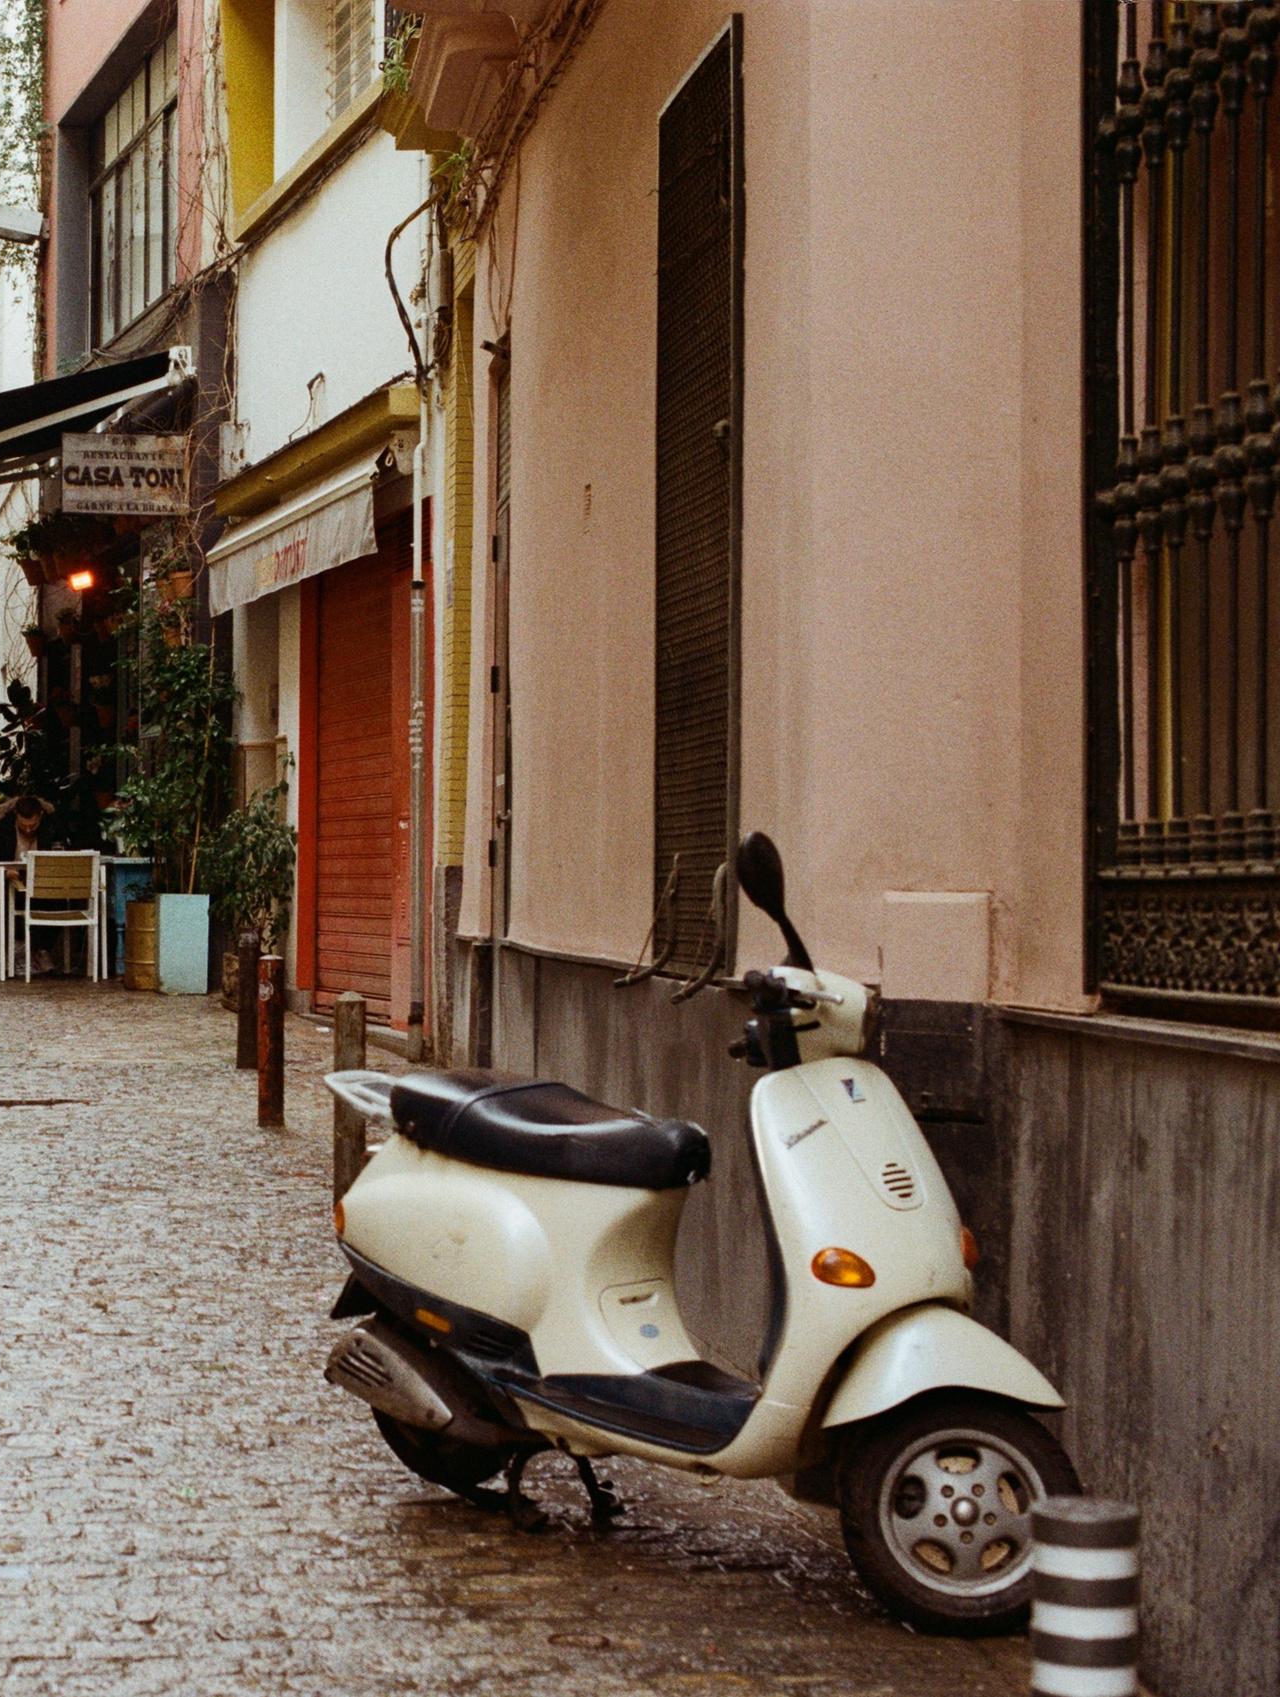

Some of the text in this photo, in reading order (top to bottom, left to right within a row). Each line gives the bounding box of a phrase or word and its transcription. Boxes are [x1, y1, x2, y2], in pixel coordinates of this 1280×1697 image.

[111, 436, 137, 446] BAR
[82, 451, 165, 461] RESTAURANTE
[63, 465, 125, 488] CASA
[126, 502, 140, 512] LA
[142, 502, 175, 513] BRASA
